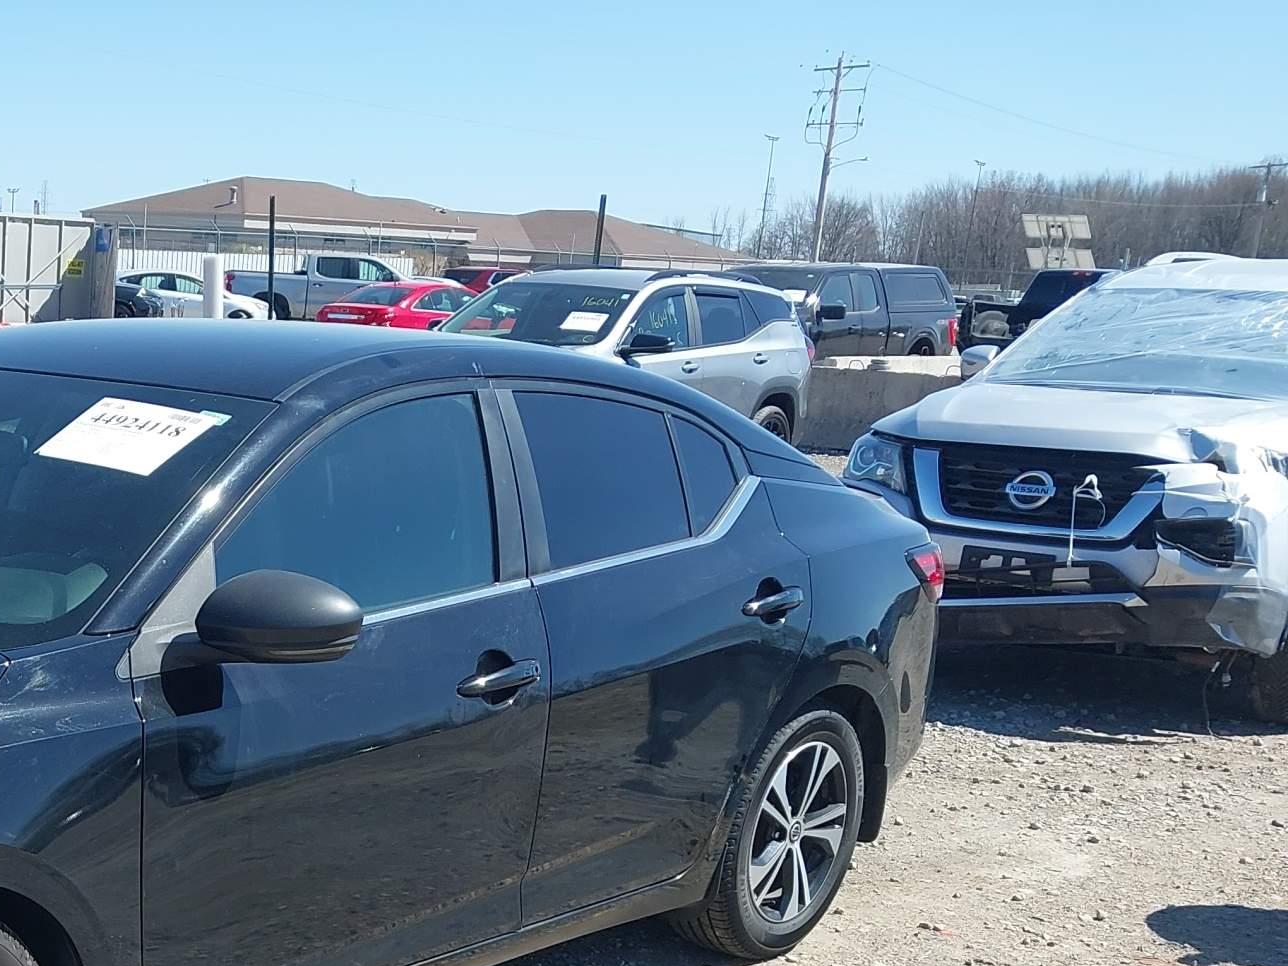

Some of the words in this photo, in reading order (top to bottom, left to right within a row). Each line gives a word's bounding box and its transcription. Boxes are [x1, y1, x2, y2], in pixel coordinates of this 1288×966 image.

[582, 296, 619, 308] 16041
[91, 412, 187, 438] 44924118
[1009, 485, 1049, 495] NISSAN
